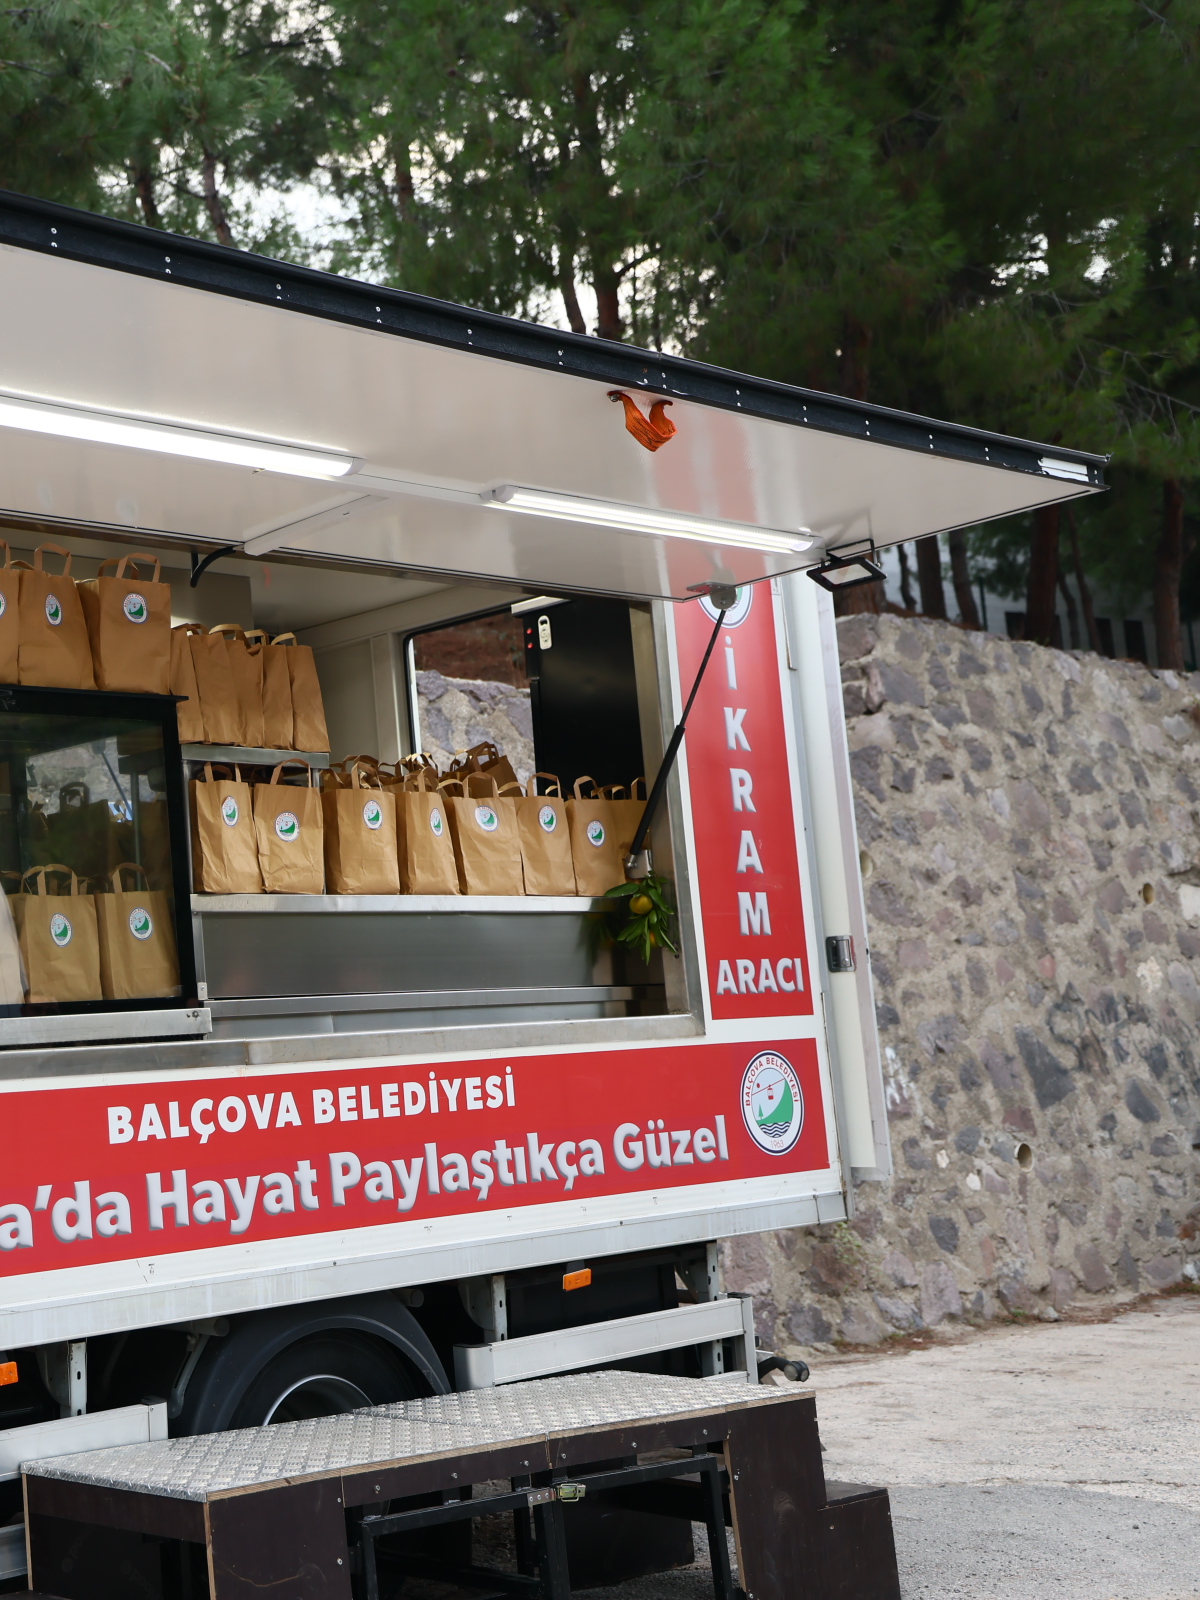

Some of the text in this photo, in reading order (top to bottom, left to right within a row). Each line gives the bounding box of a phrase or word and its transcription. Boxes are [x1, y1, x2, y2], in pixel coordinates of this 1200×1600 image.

[716, 957, 804, 995] ARACI
[107, 1066, 515, 1144] BALÇOVA BELEDİYESİ
[770, 1140, 784, 1149] 1963
[145, 1160, 319, 1236] Hayat
[329, 1132, 604, 1212] Paylaştıkça
[613, 1115, 729, 1171] Güzel
